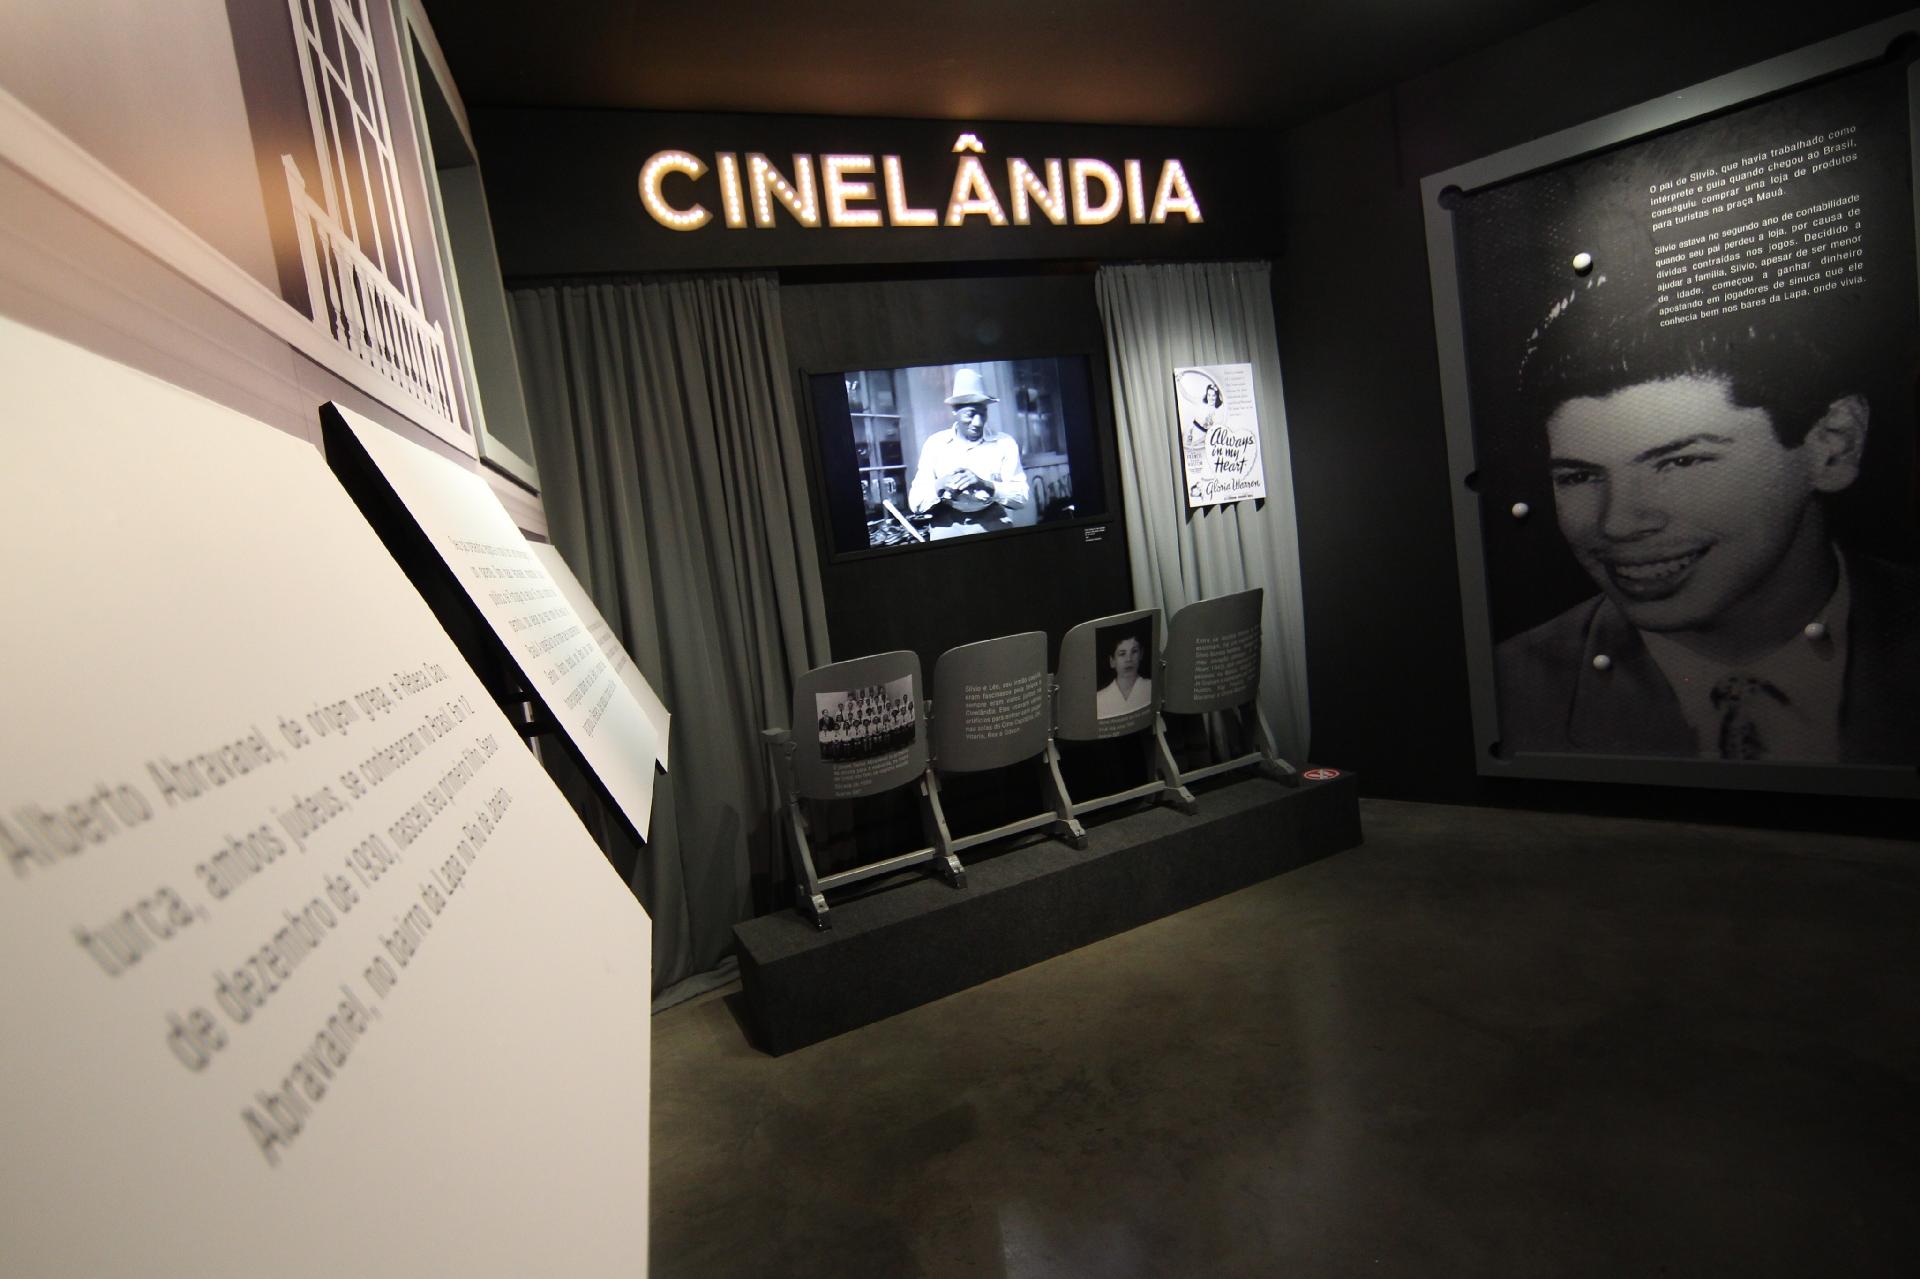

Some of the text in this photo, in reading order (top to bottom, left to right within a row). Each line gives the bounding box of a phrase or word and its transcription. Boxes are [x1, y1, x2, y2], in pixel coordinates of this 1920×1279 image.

[638, 133, 1204, 232] CINELÂNDIA
[1649, 186, 1656, 194] O
[1660, 181, 1673, 192] pai
[1676, 177, 1687, 186] de
[1721, 162, 1738, 173] que
[1741, 153, 1767, 167] havia
[1770, 135, 1824, 157] trabalhado
[1828, 126, 1856, 140] como
[1651, 153, 1858, 218] conseguiu comprar uma loja de produtos
[1706, 178, 1726, 191] guia
[1730, 166, 1764, 184] quando
[1768, 157, 1803, 172] chegou
[1807, 150, 1820, 160] ao
[1652, 219, 1672, 232] para
[1675, 210, 1709, 225] turistas
[1712, 205, 1724, 215] na
[1727, 198, 1753, 212] praça
[1655, 252, 1686, 268] quando
[1688, 244, 1703, 257] seu
[1708, 244, 1721, 254] pai
[1724, 234, 1755, 249] perdeu
[1759, 233, 1764, 241] a
[1792, 221, 1808, 233] por
[1813, 212, 1842, 227] causa
[1848, 208, 1860, 217] de
[1679, 236, 1705, 249] estava
[1709, 233, 1718, 242] no
[1722, 221, 1759, 238] segundo
[1762, 217, 1778, 227] ano
[1782, 212, 1793, 222] de
[1796, 194, 1860, 217] contabilidade
[1746, 246, 1763, 256] nos
[1804, 225, 1848, 242] Decidido
[1855, 221, 1861, 229] a
[1657, 277, 1683, 292] ajudar
[1686, 276, 1692, 284] a
[1761, 252, 1792, 266] apesar
[1796, 248, 1807, 258] de
[1812, 244, 1826, 254] ser
[1830, 235, 1862, 249] menor
[1658, 293, 1669, 303] de
[1712, 275, 1753, 291] começou
[1763, 270, 1768, 279] a
[1777, 260, 1812, 277] ganhar
[1821, 247, 1863, 265] dinheiro
[1659, 261, 1863, 316] apostando em jogadores de sinuca que ele
[1660, 310, 1697, 327] conhecia
[1700, 305, 1718, 319] bem
[1722, 302, 1738, 313] nos
[1741, 296, 1766, 310] bares
[1769, 293, 1781, 303] da
[1813, 279, 1837, 293] onde
[1210, 427, 1254, 454] Always
[1212, 445, 1240, 461] in my
[1215, 457, 1247, 473] Heart
[1206, 480, 1231, 500] Gloria
[1232, 478, 1260, 491] Warren
[0, 778, 153, 880] Alberto
[145, 724, 288, 808] Abravanel,
[277, 713, 311, 750] de
[306, 700, 360, 736] origem
[389, 682, 403, 700] e
[71, 885, 211, 979] turca,
[194, 823, 287, 900] ambos
[269, 785, 354, 854] judeus,
[340, 770, 368, 800] se
[359, 731, 426, 787] conheceram
[417, 723, 437, 747] no
[446, 702, 467, 723] Em
[462, 822, 487, 851] Rio
[475, 810, 495, 836] de
[456, 839, 477, 867] no
[418, 881, 447, 916] da
[163, 1005, 230, 1075] de
[211, 895, 340, 1026] dezembro
[323, 869, 361, 915] de
[344, 831, 404, 890] 1930,
[387, 802, 433, 851] nasceu
[423, 785, 449, 815] seu
[377, 902, 434, 969] bairro
[363, 953, 399, 1002] no
[240, 982, 383, 1172] Abravanel,
